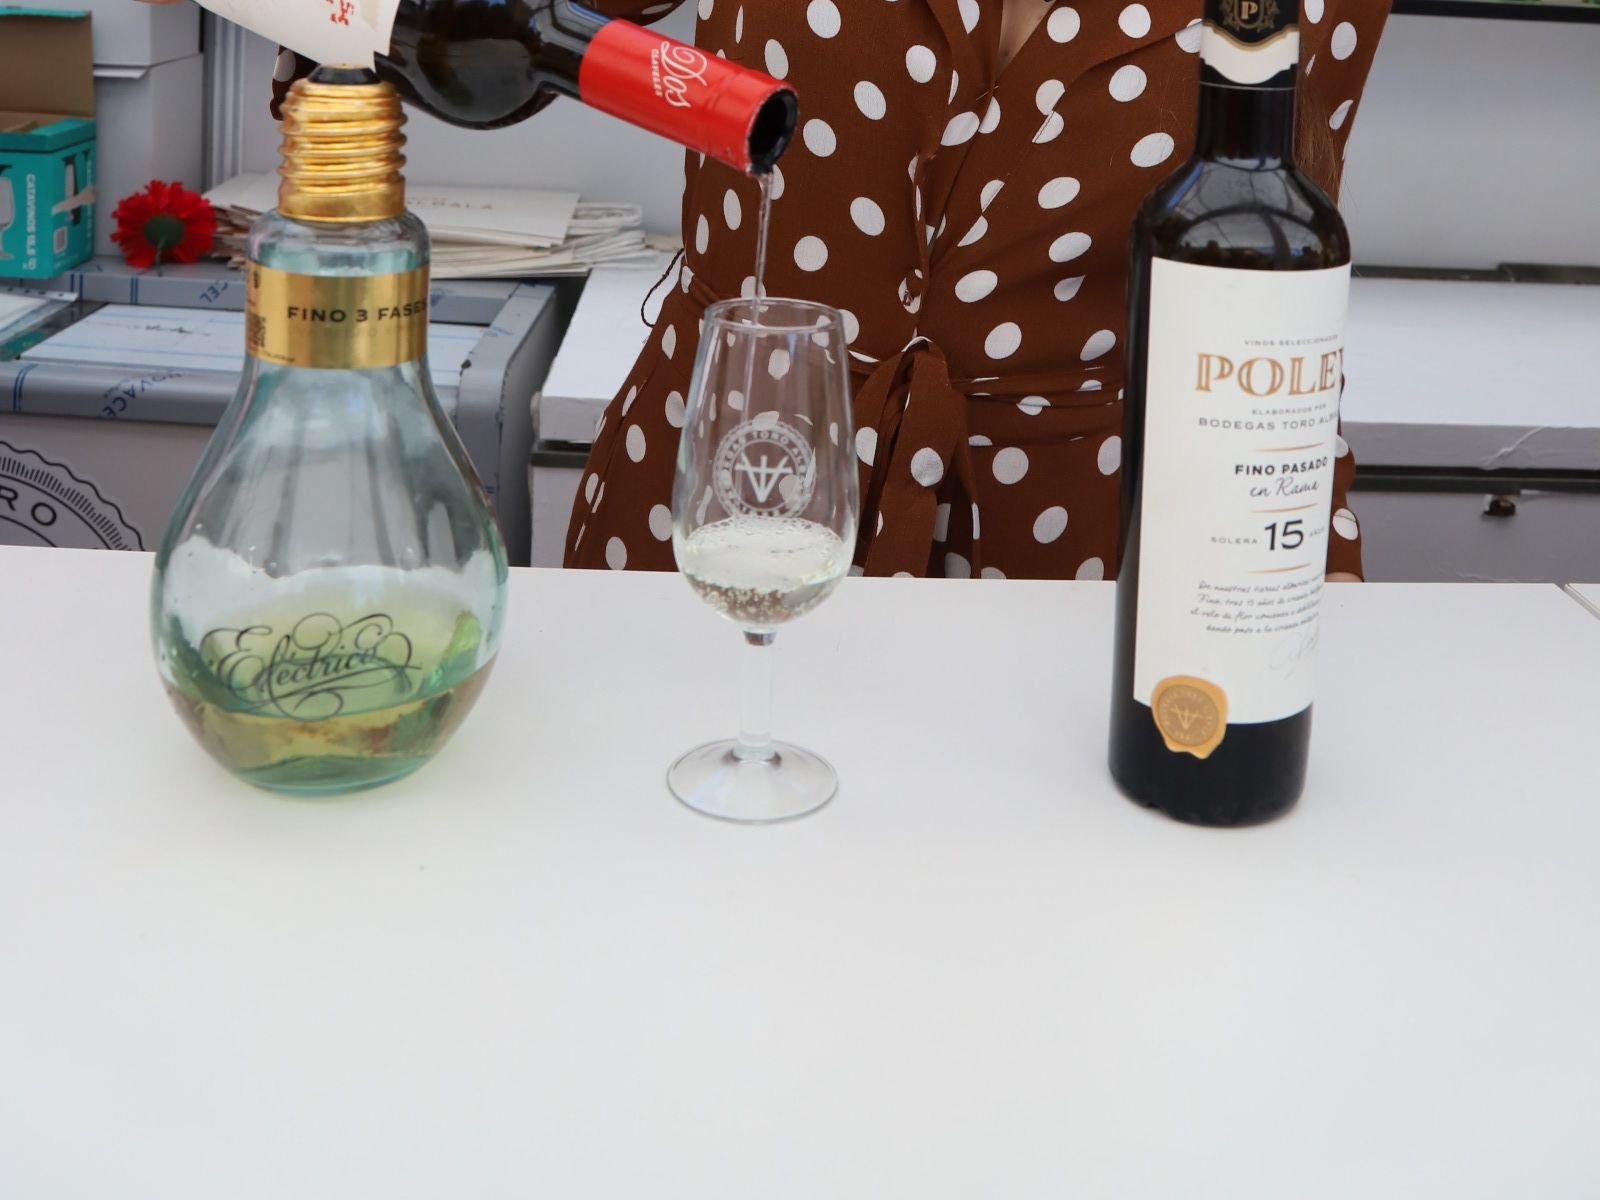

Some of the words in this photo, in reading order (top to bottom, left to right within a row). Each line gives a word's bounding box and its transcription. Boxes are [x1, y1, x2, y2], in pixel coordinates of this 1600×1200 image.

[1240, 1, 1258, 20] P
[287, 306, 346, 323] FINO
[355, 309, 368, 322] 3
[1199, 417, 1276, 431] BODEGAS
[1282, 419, 1316, 430] TORO
[1235, 464, 1275, 476] FINO
[1282, 456, 1328, 474] PASADO
[1249, 487, 1271, 497] en
[1211, 536, 1258, 545] SOLERA
[1264, 519, 1304, 551] 15
